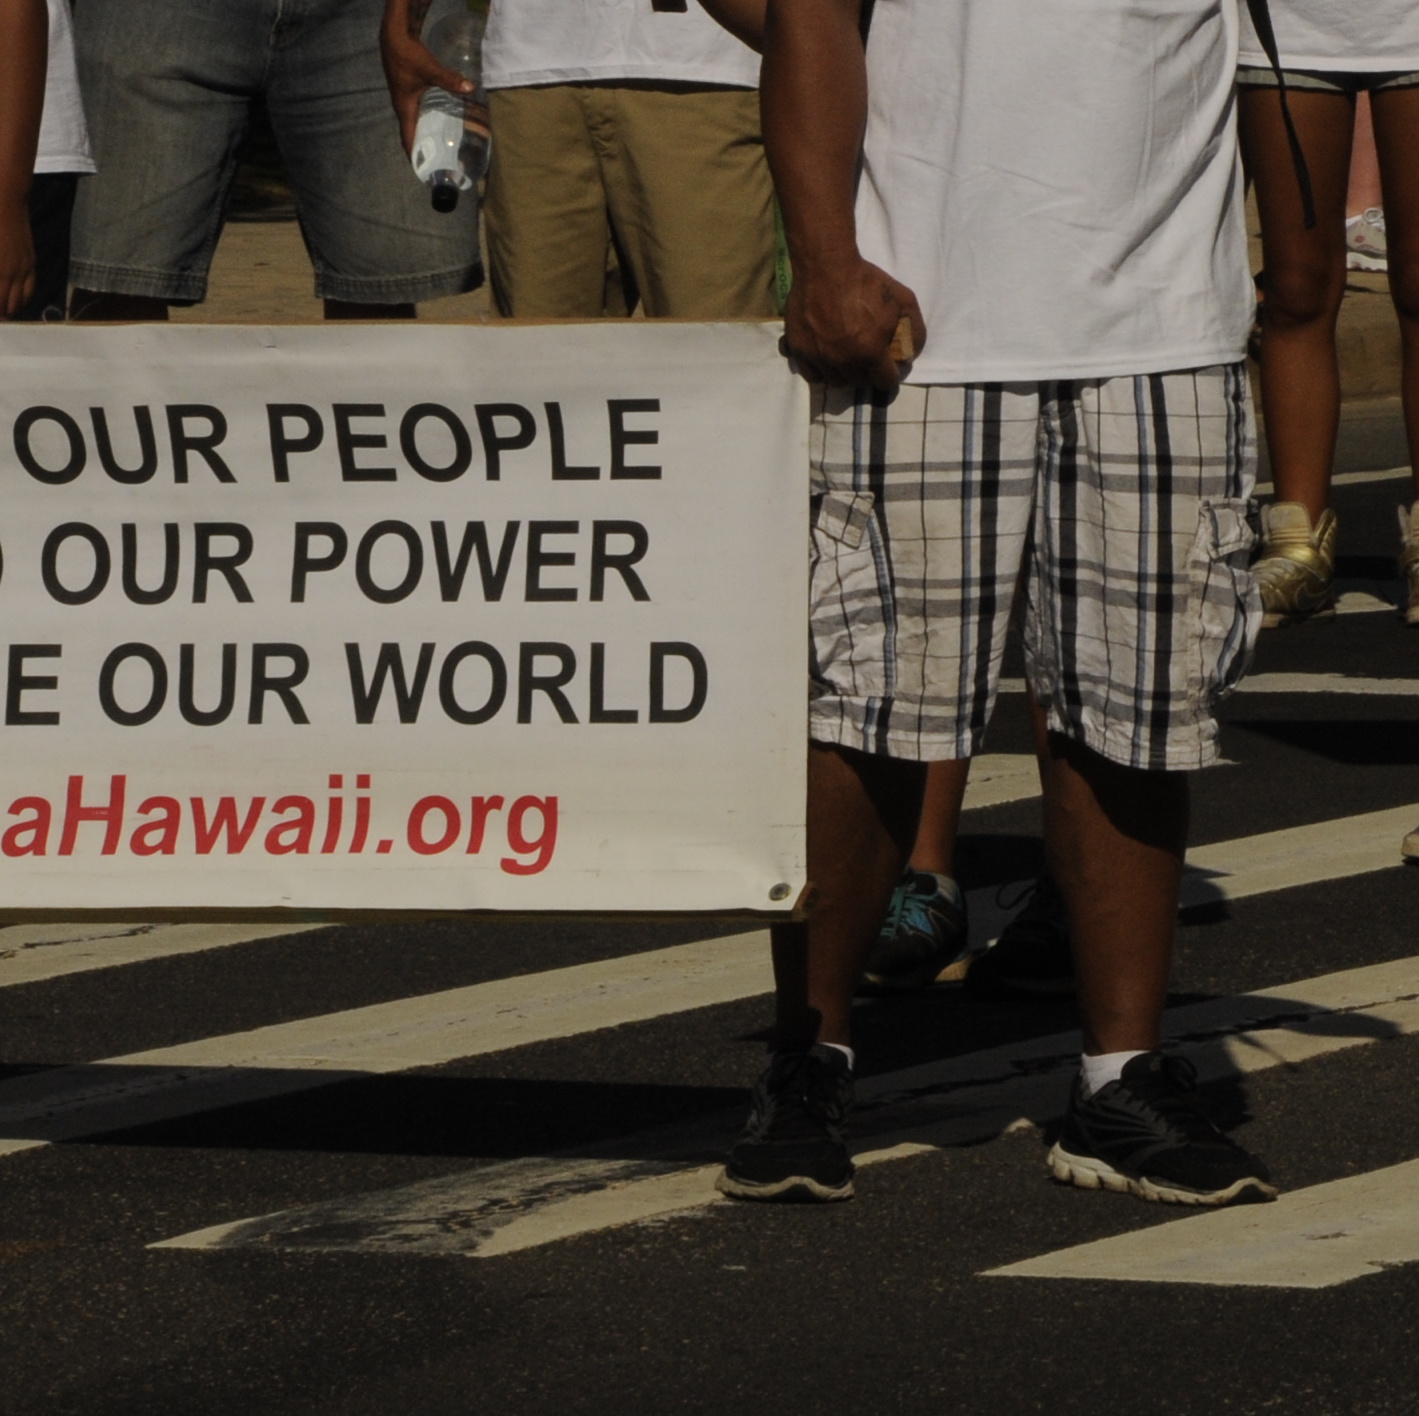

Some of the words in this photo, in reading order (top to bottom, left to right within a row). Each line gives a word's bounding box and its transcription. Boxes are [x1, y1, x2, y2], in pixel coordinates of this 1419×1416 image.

[13, 404, 237, 484] OUR
[266, 399, 662, 482] PEOPLE
[42, 522, 253, 605] OUR
[291, 520, 650, 604] POWER
[99, 643, 309, 726] OUR
[345, 641, 707, 725] WORLD
